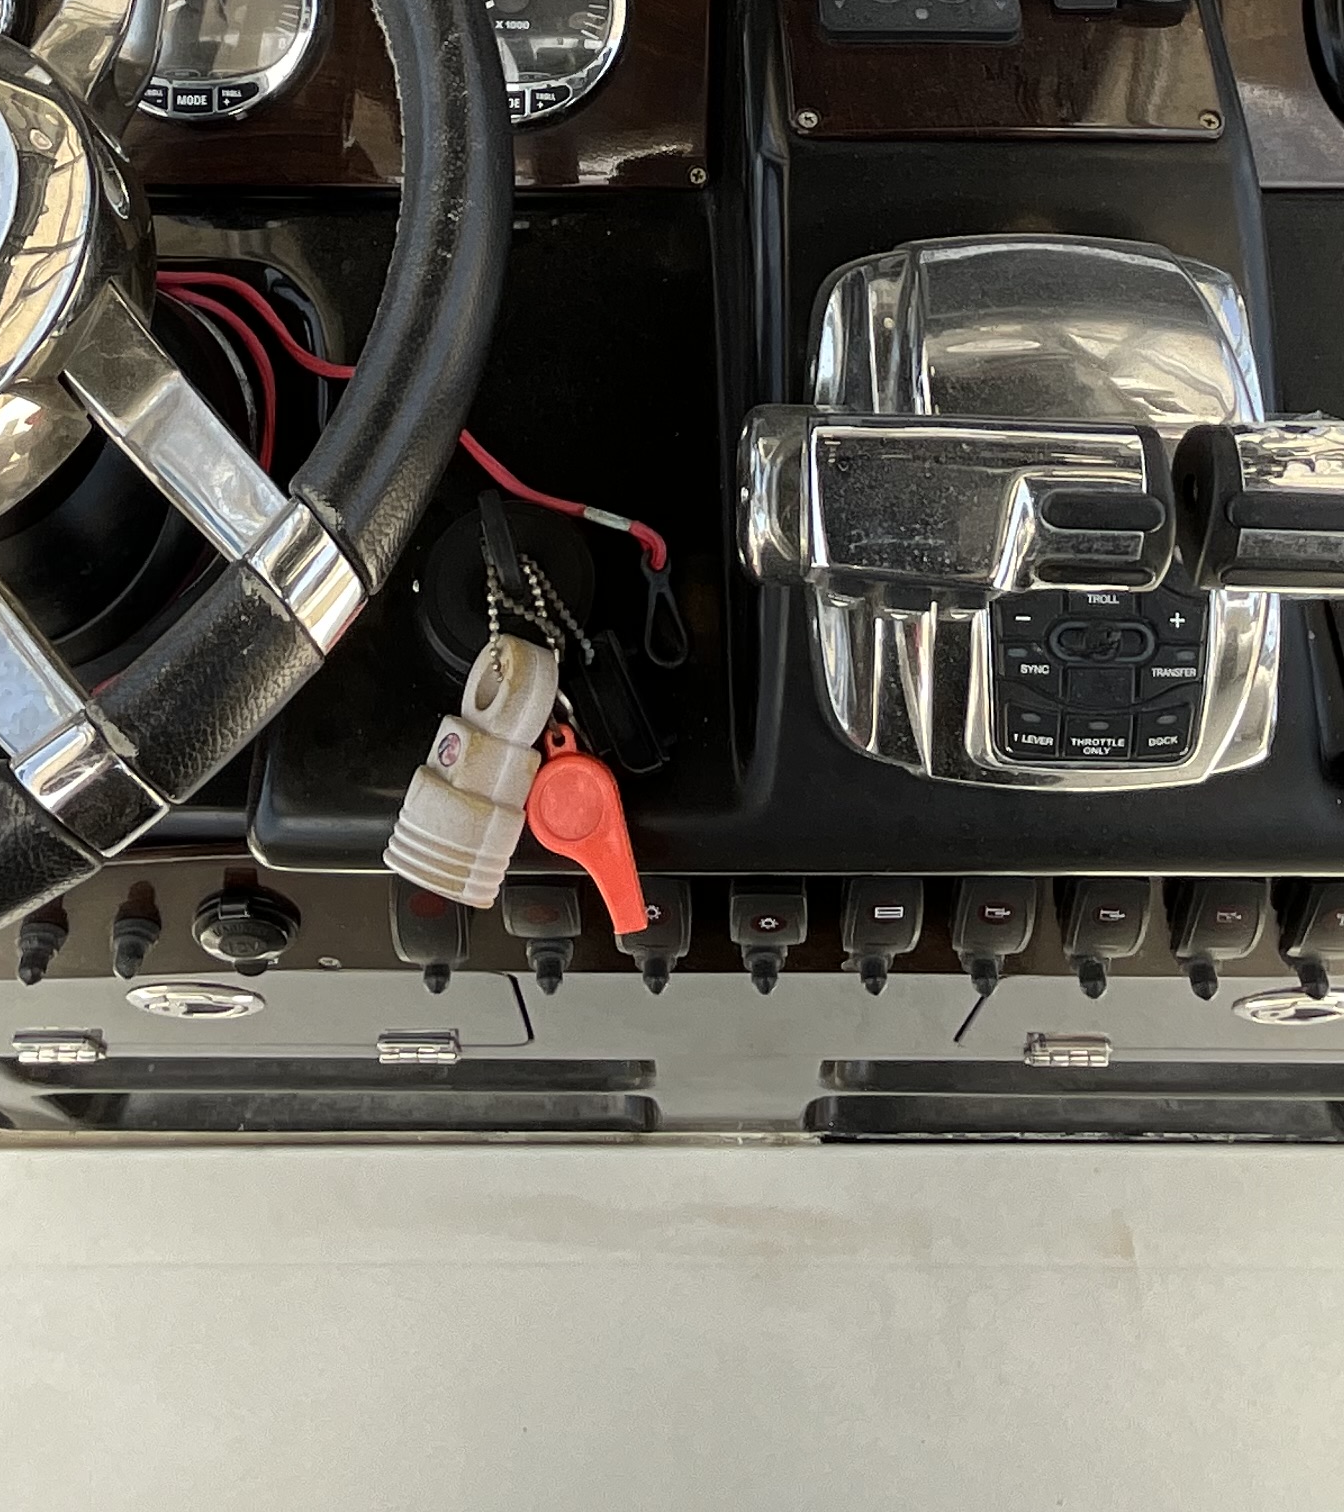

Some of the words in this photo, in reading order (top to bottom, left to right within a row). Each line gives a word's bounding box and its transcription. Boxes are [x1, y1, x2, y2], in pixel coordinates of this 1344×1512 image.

[494, 20, 504, 29] X
[505, 20, 530, 30] 1000
[176, 94, 208, 106] MODE
[1087, 593, 1120, 604] TROLL
[1019, 663, 1050, 675] SYNC
[1151, 667, 1197, 678] TRANSFER
[1021, 736, 1054, 746] LEVER
[1070, 737, 1125, 747] THROTTLE
[1148, 735, 1179, 747] DOCK
[1082, 746, 1112, 755] ONLY
